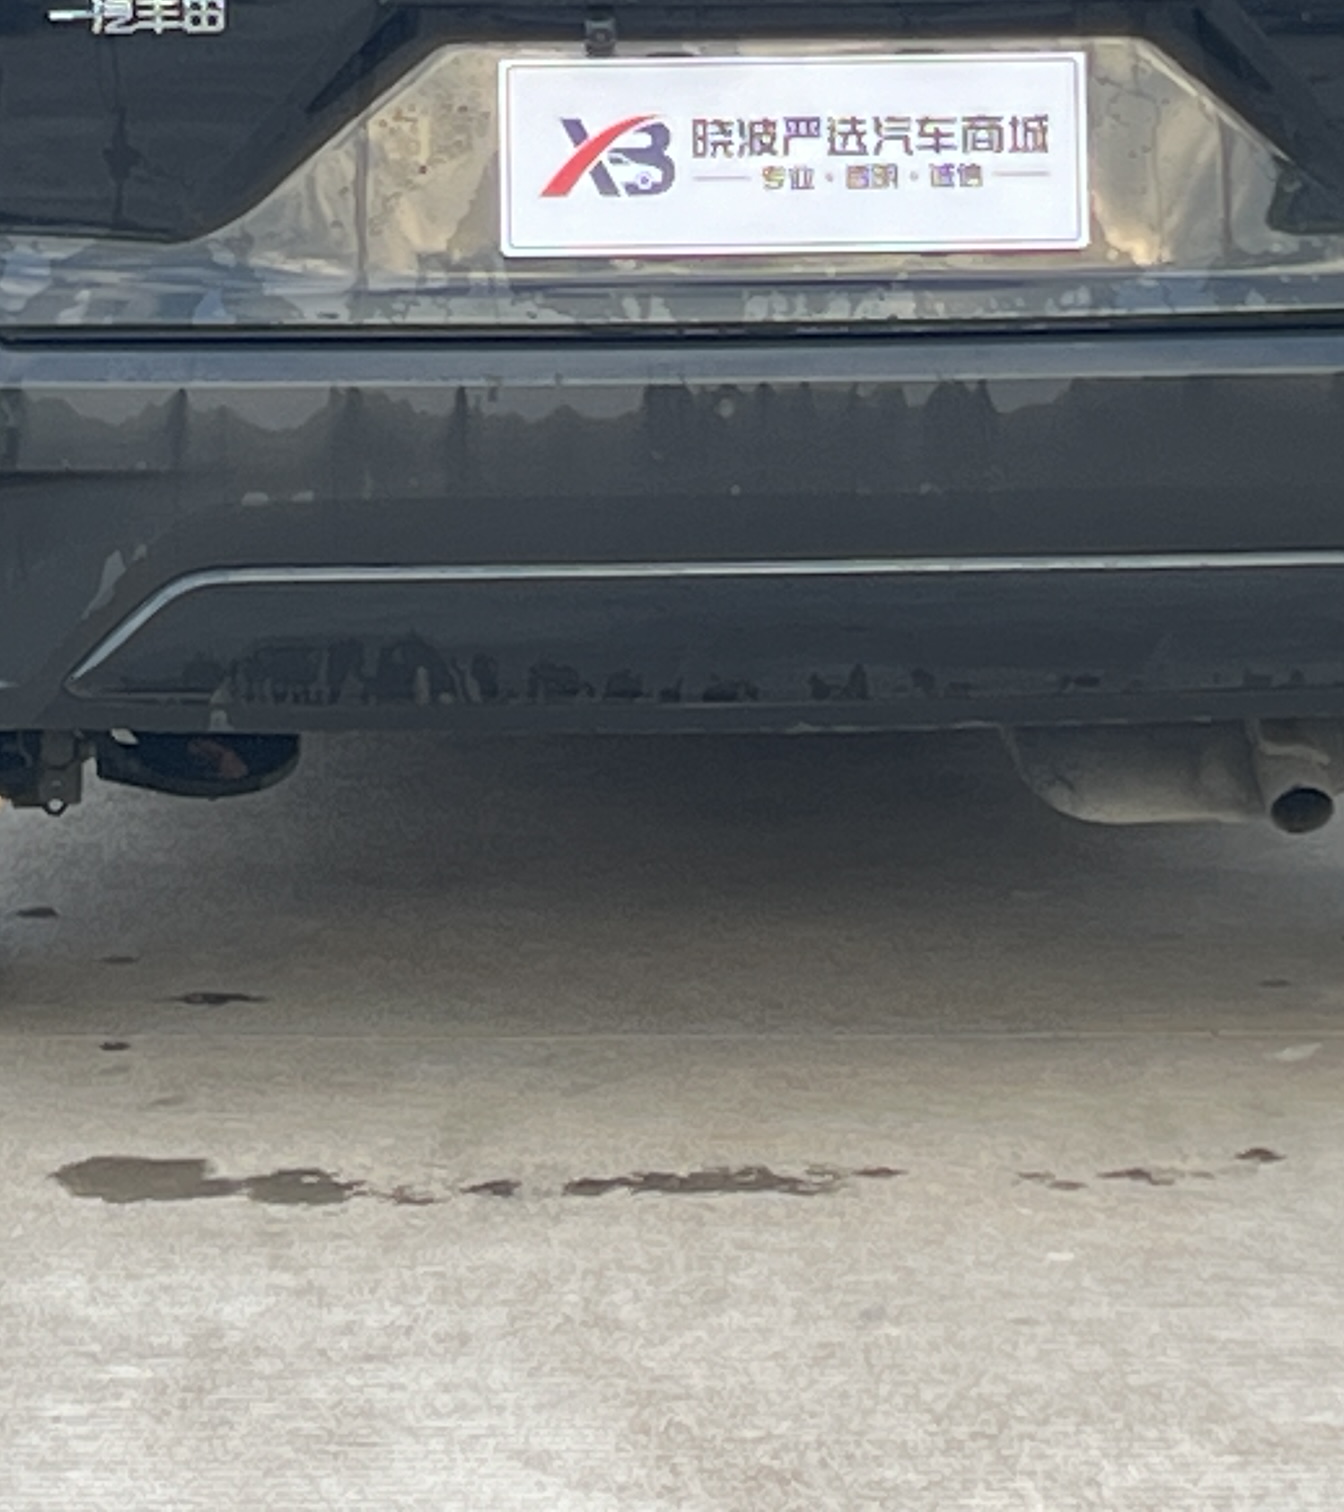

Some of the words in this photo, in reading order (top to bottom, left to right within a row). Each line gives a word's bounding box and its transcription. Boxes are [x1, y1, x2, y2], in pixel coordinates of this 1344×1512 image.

[692, 114, 1050, 159] 晓波严选汽车商城
